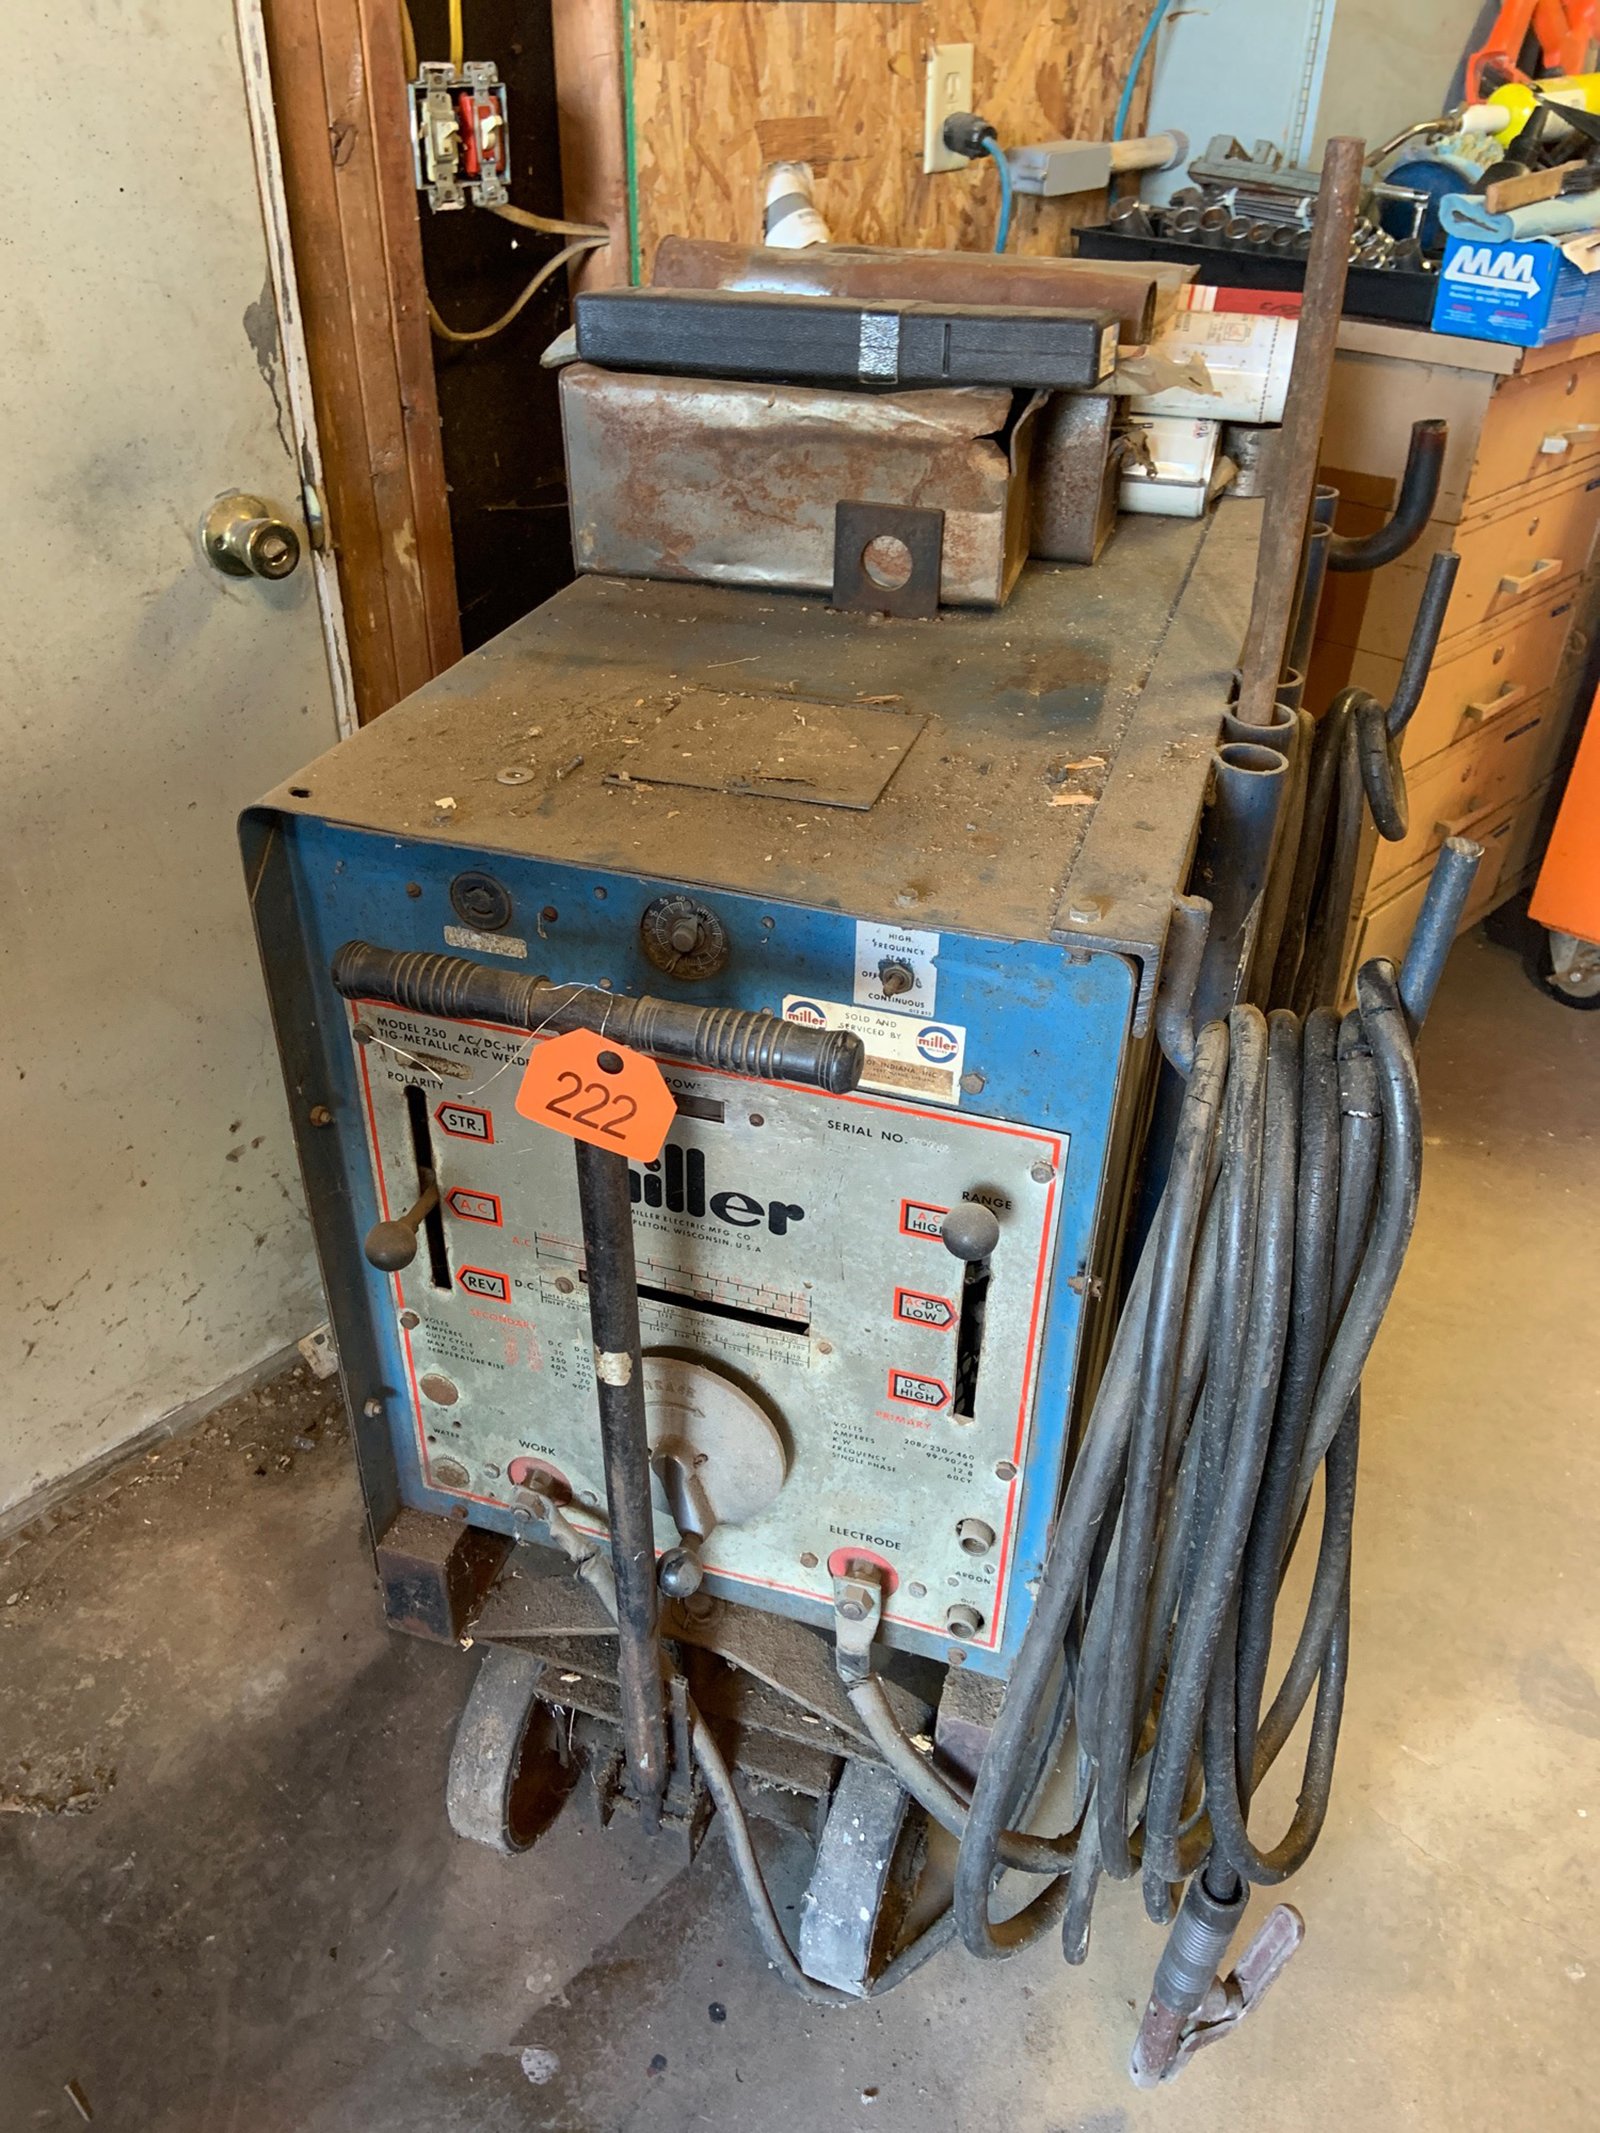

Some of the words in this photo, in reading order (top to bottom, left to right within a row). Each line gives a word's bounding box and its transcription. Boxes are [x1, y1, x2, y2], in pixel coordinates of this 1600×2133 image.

[873, 941, 925, 955] FREQUENCY
[868, 992, 925, 1009] CONTINUOUS
[788, 1009, 825, 1026] miller
[845, 1012, 870, 1024] SOLD
[876, 1018, 897, 1029] AND
[377, 1017, 418, 1034] MODEL
[425, 1026, 447, 1039] 250
[840, 1022, 885, 1038] SERVICED
[890, 1032, 902, 1040] BY
[379, 1028, 465, 1054] TIG-METALLIC
[463, 1046, 488, 1060] ARC
[918, 1035, 957, 1052] miller
[387, 1071, 444, 1091] POLARITY
[545, 1071, 637, 1140] 222
[449, 1113, 482, 1132] STR.
[827, 1119, 873, 1138] SERIAL
[881, 1131, 909, 1145] NO.
[962, 1190, 1013, 1211] RANGE
[663, 1215, 706, 1231] ELECTRIC
[468, 1276, 502, 1294] REV.
[904, 1296, 943, 1313] AC-DC
[906, 1307, 937, 1321] LOW
[901, 1389, 935, 1403] HIGH
[875, 1410, 932, 1430] PRIMARY
[518, 1439, 556, 1457] WORK
[829, 1524, 901, 1551] ELECTRODE
[955, 1570, 991, 1585] ARGON
